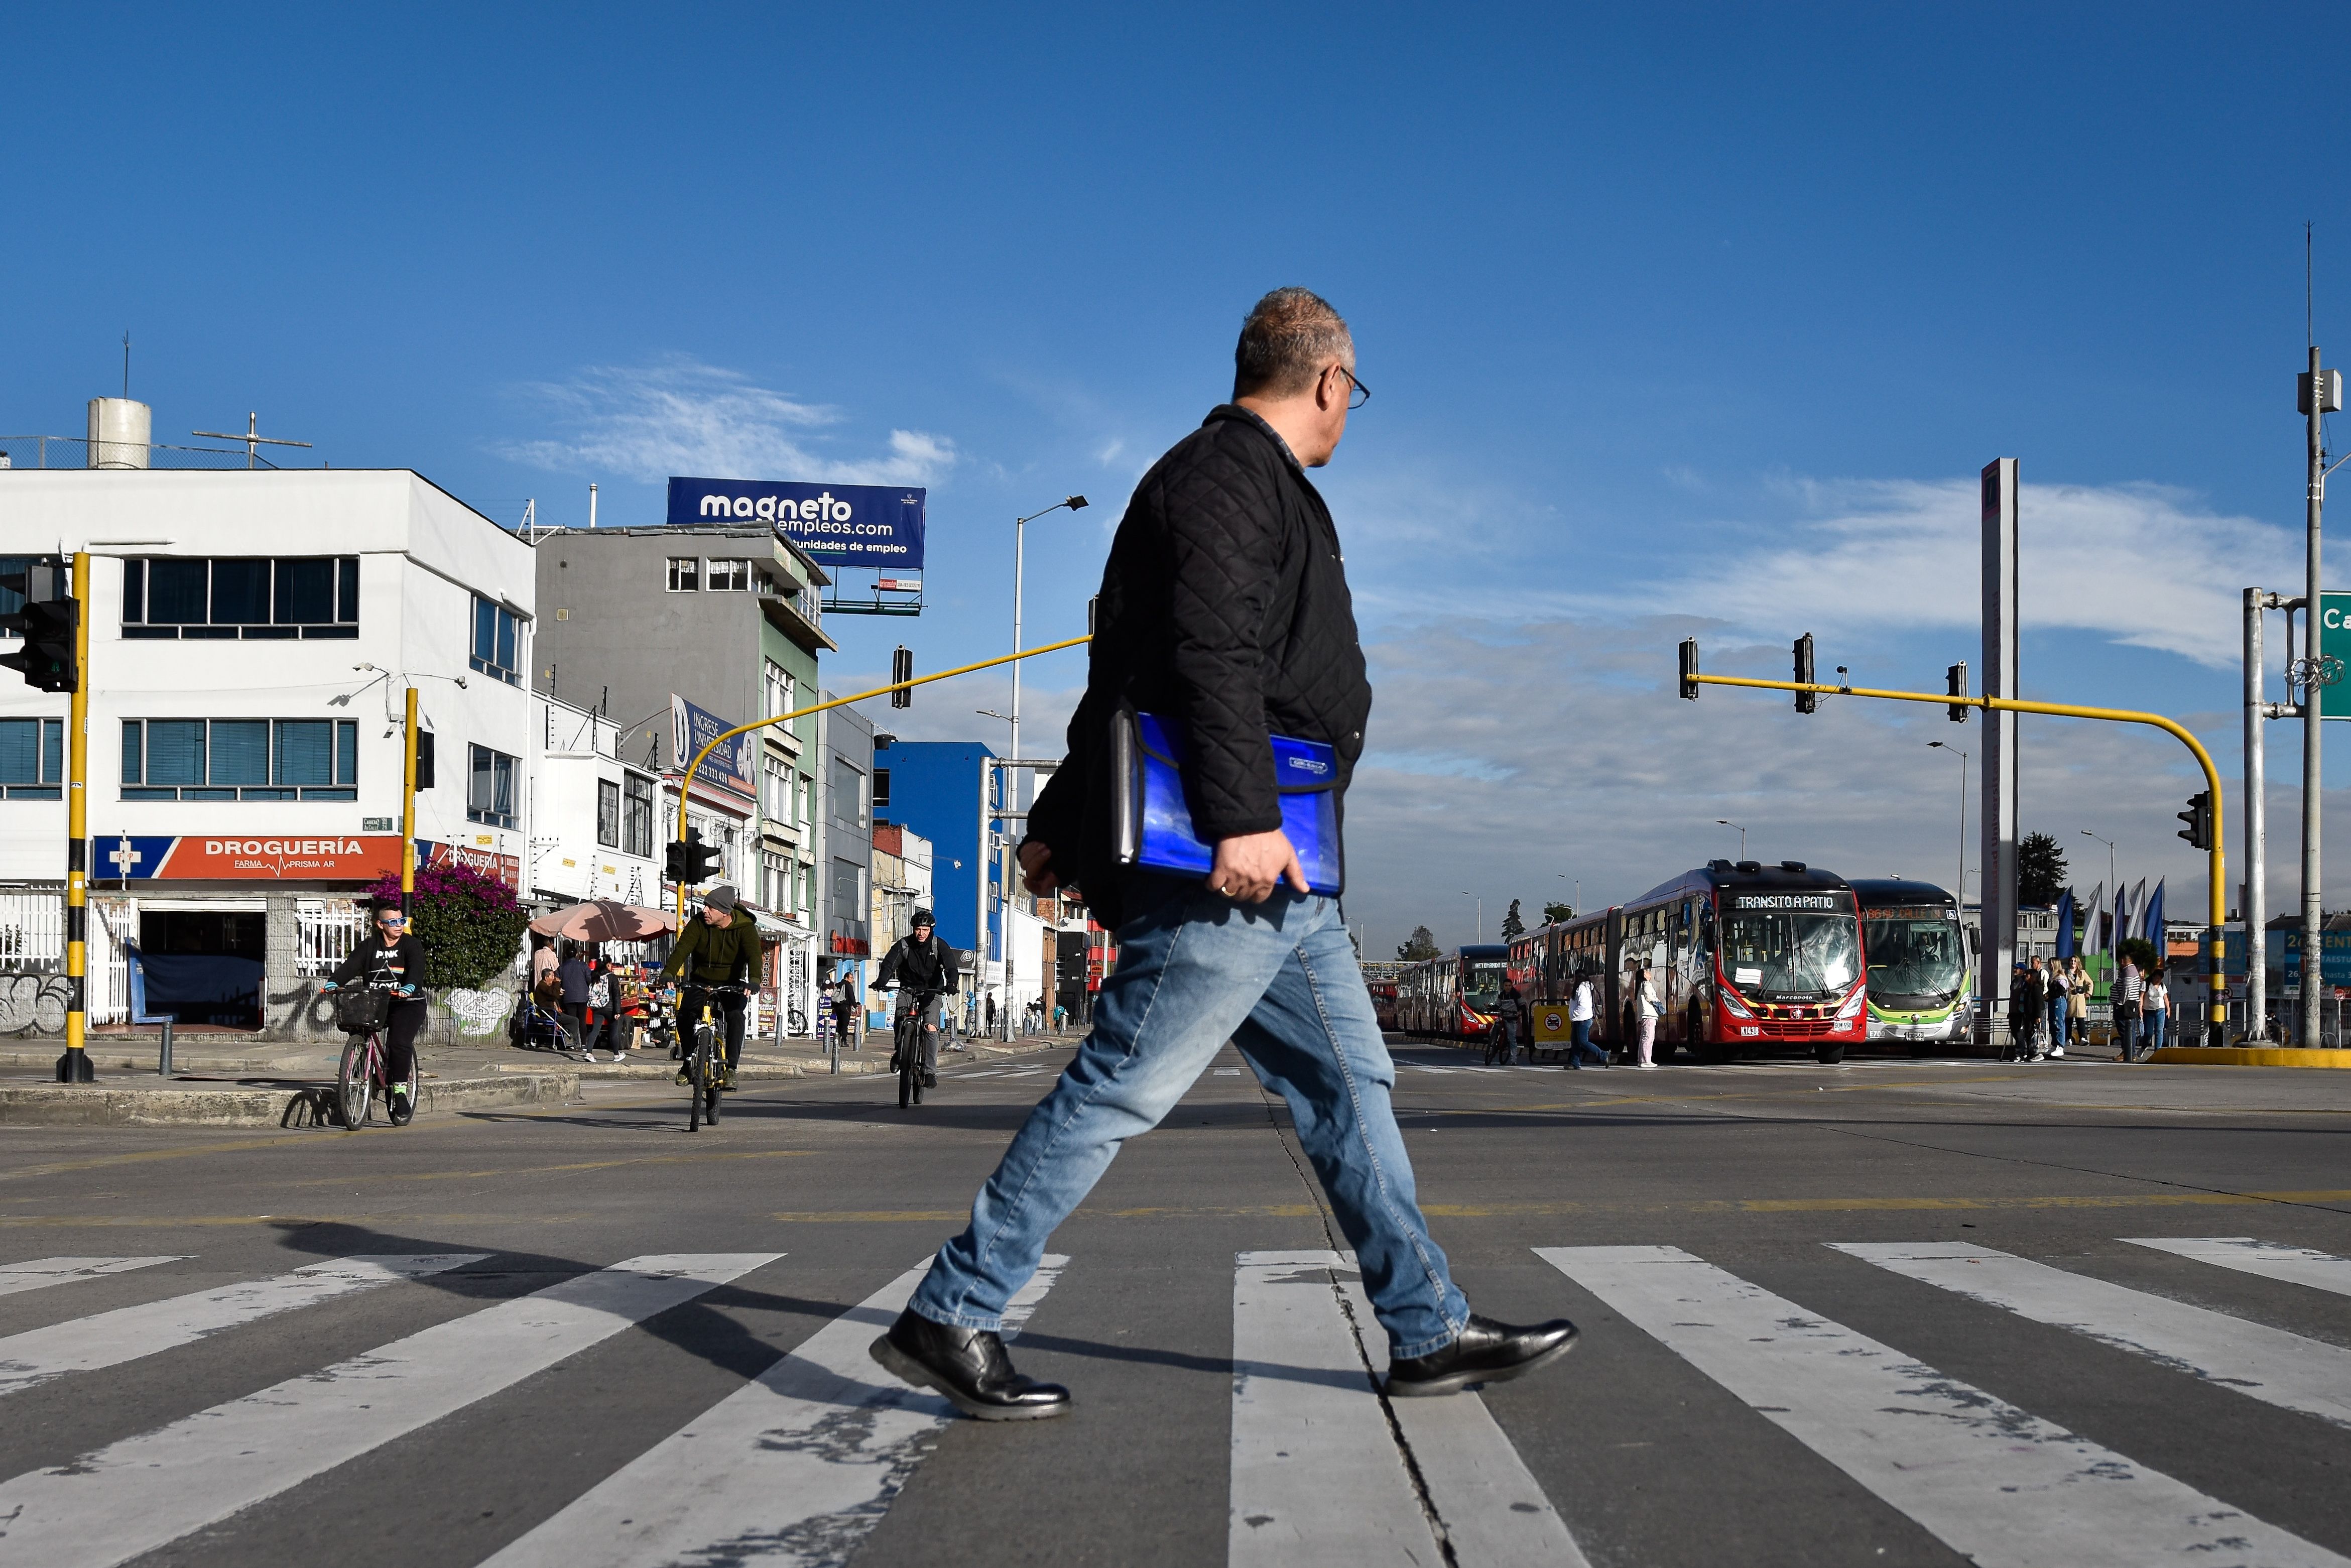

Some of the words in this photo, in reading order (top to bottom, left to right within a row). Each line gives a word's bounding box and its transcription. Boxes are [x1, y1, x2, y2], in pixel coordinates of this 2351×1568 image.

[700, 492, 851, 522] magneto
[778, 519, 893, 536] empleos.com
[793, 539, 847, 550] tunidades
[849, 542, 863, 551] de
[866, 544, 907, 554] empleo
[694, 711, 718, 738] INGRESE
[699, 763, 708, 776] 222
[709, 767, 718, 780] 333
[719, 771, 728, 784] 426
[206, 836, 363, 855] DROGUERÍA
[1739, 896, 1792, 908] TRANSITO
[1794, 896, 1801, 908] A
[1803, 896, 1833, 908] PATIO
[2319, 936, 2351, 948] ENT
[376, 950, 399, 959] PINK
[1741, 1026, 1759, 1035] K1438
